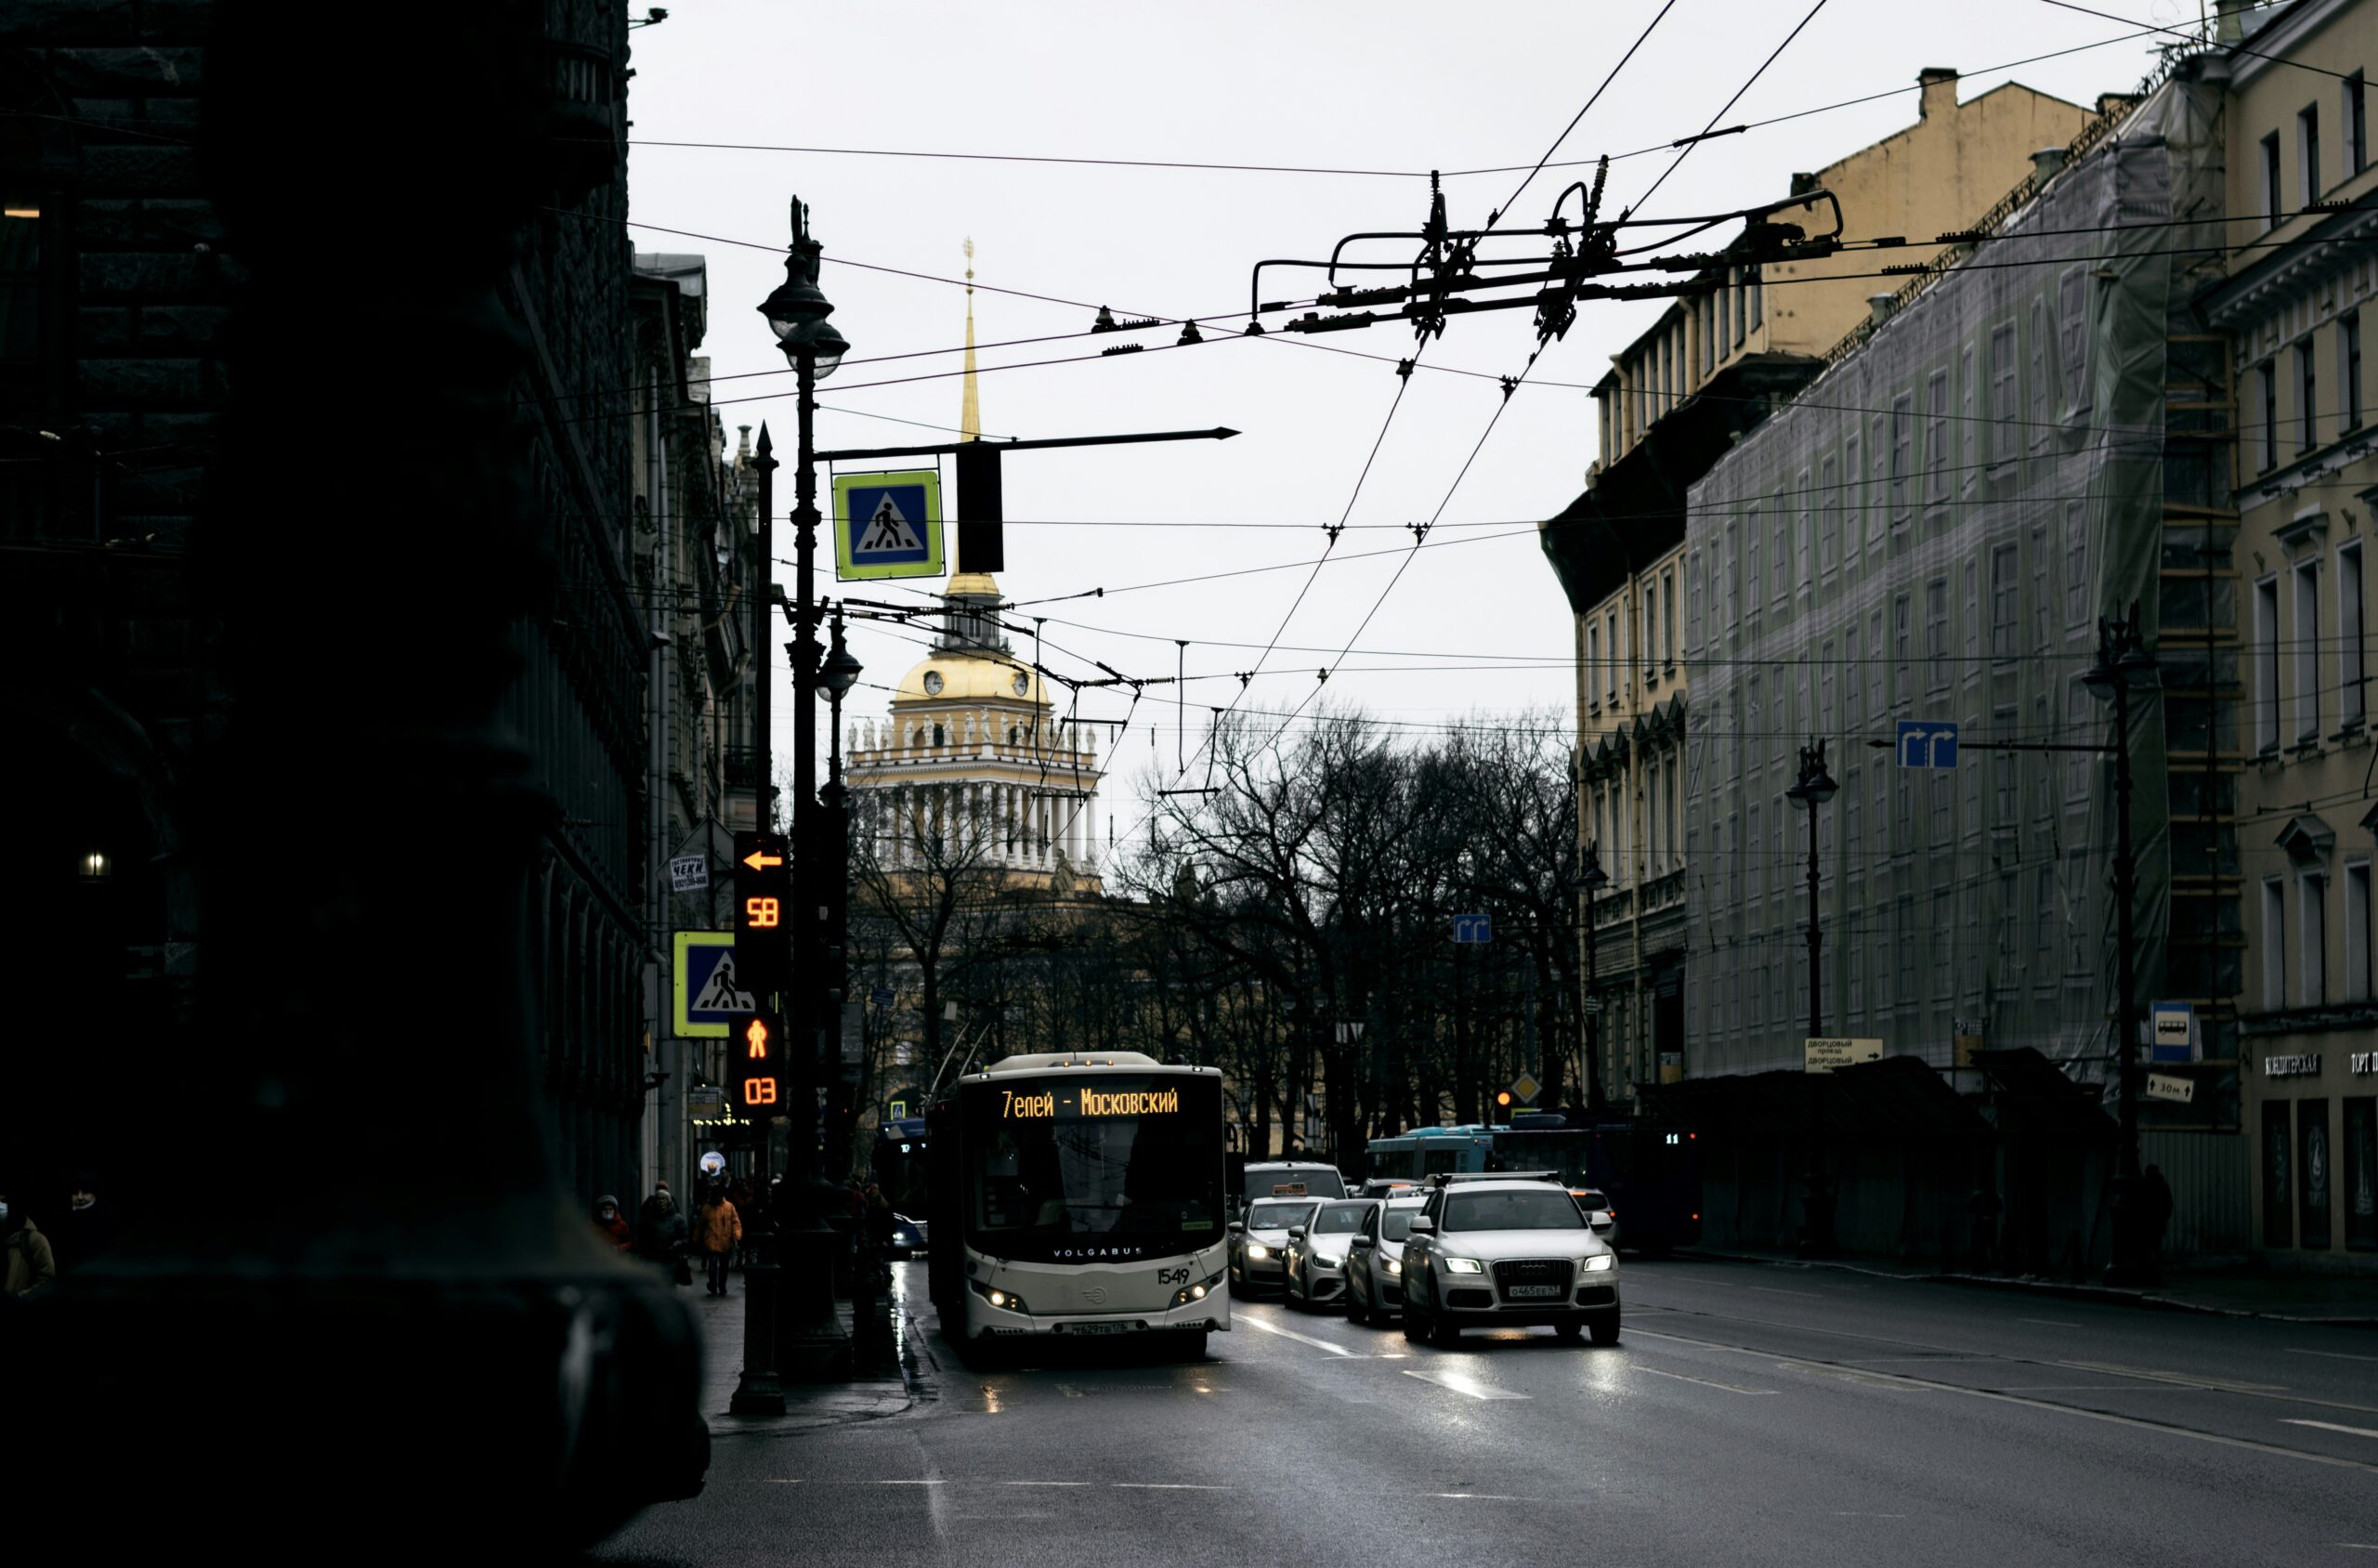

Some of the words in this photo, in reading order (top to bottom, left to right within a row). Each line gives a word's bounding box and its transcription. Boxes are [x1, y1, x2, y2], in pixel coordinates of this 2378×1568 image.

[673, 864, 703, 876] ЧЕКИ
[747, 896, 779, 927] 58
[1808, 1040, 1852, 1049] ДВОРЦОВЫЙ
[1808, 1057, 1852, 1065] ДВОРЦОВЫЙ
[2266, 1054, 2318, 1077] КОНДИТЕРСКАЯ
[2351, 1052, 2370, 1074] ТОРТ
[745, 1077, 777, 1105] 03
[1080, 1087, 1179, 1116] Московский
[1666, 1132, 1679, 1144] 11
[1053, 1247, 1143, 1258] VOLGABUS
[1157, 1268, 1190, 1285] 1549
